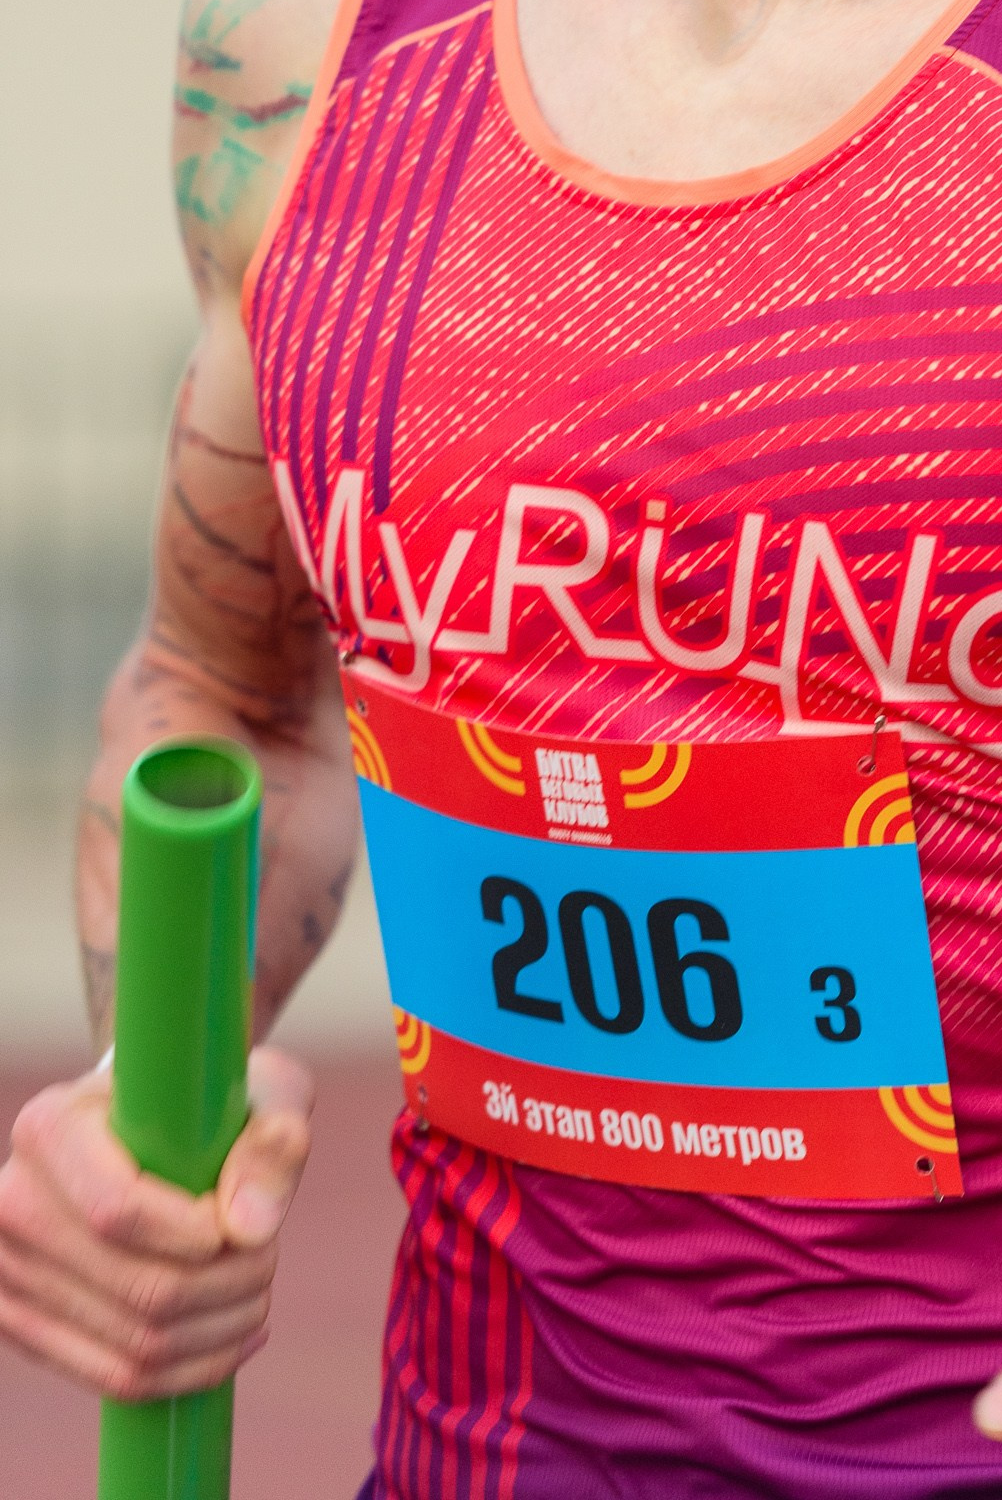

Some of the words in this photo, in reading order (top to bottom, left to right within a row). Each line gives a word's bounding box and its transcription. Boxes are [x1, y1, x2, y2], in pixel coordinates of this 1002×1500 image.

[534, 747, 602, 782] БИТВА
[543, 798, 609, 829] КЛУБОВ
[480, 875, 743, 1043] 206
[809, 966, 862, 1043] 3
[482, 1080, 519, 1124] 3й
[523, 1098, 595, 1143] этап
[600, 1108, 665, 1152] 800
[671, 1121, 807, 1166] метров
